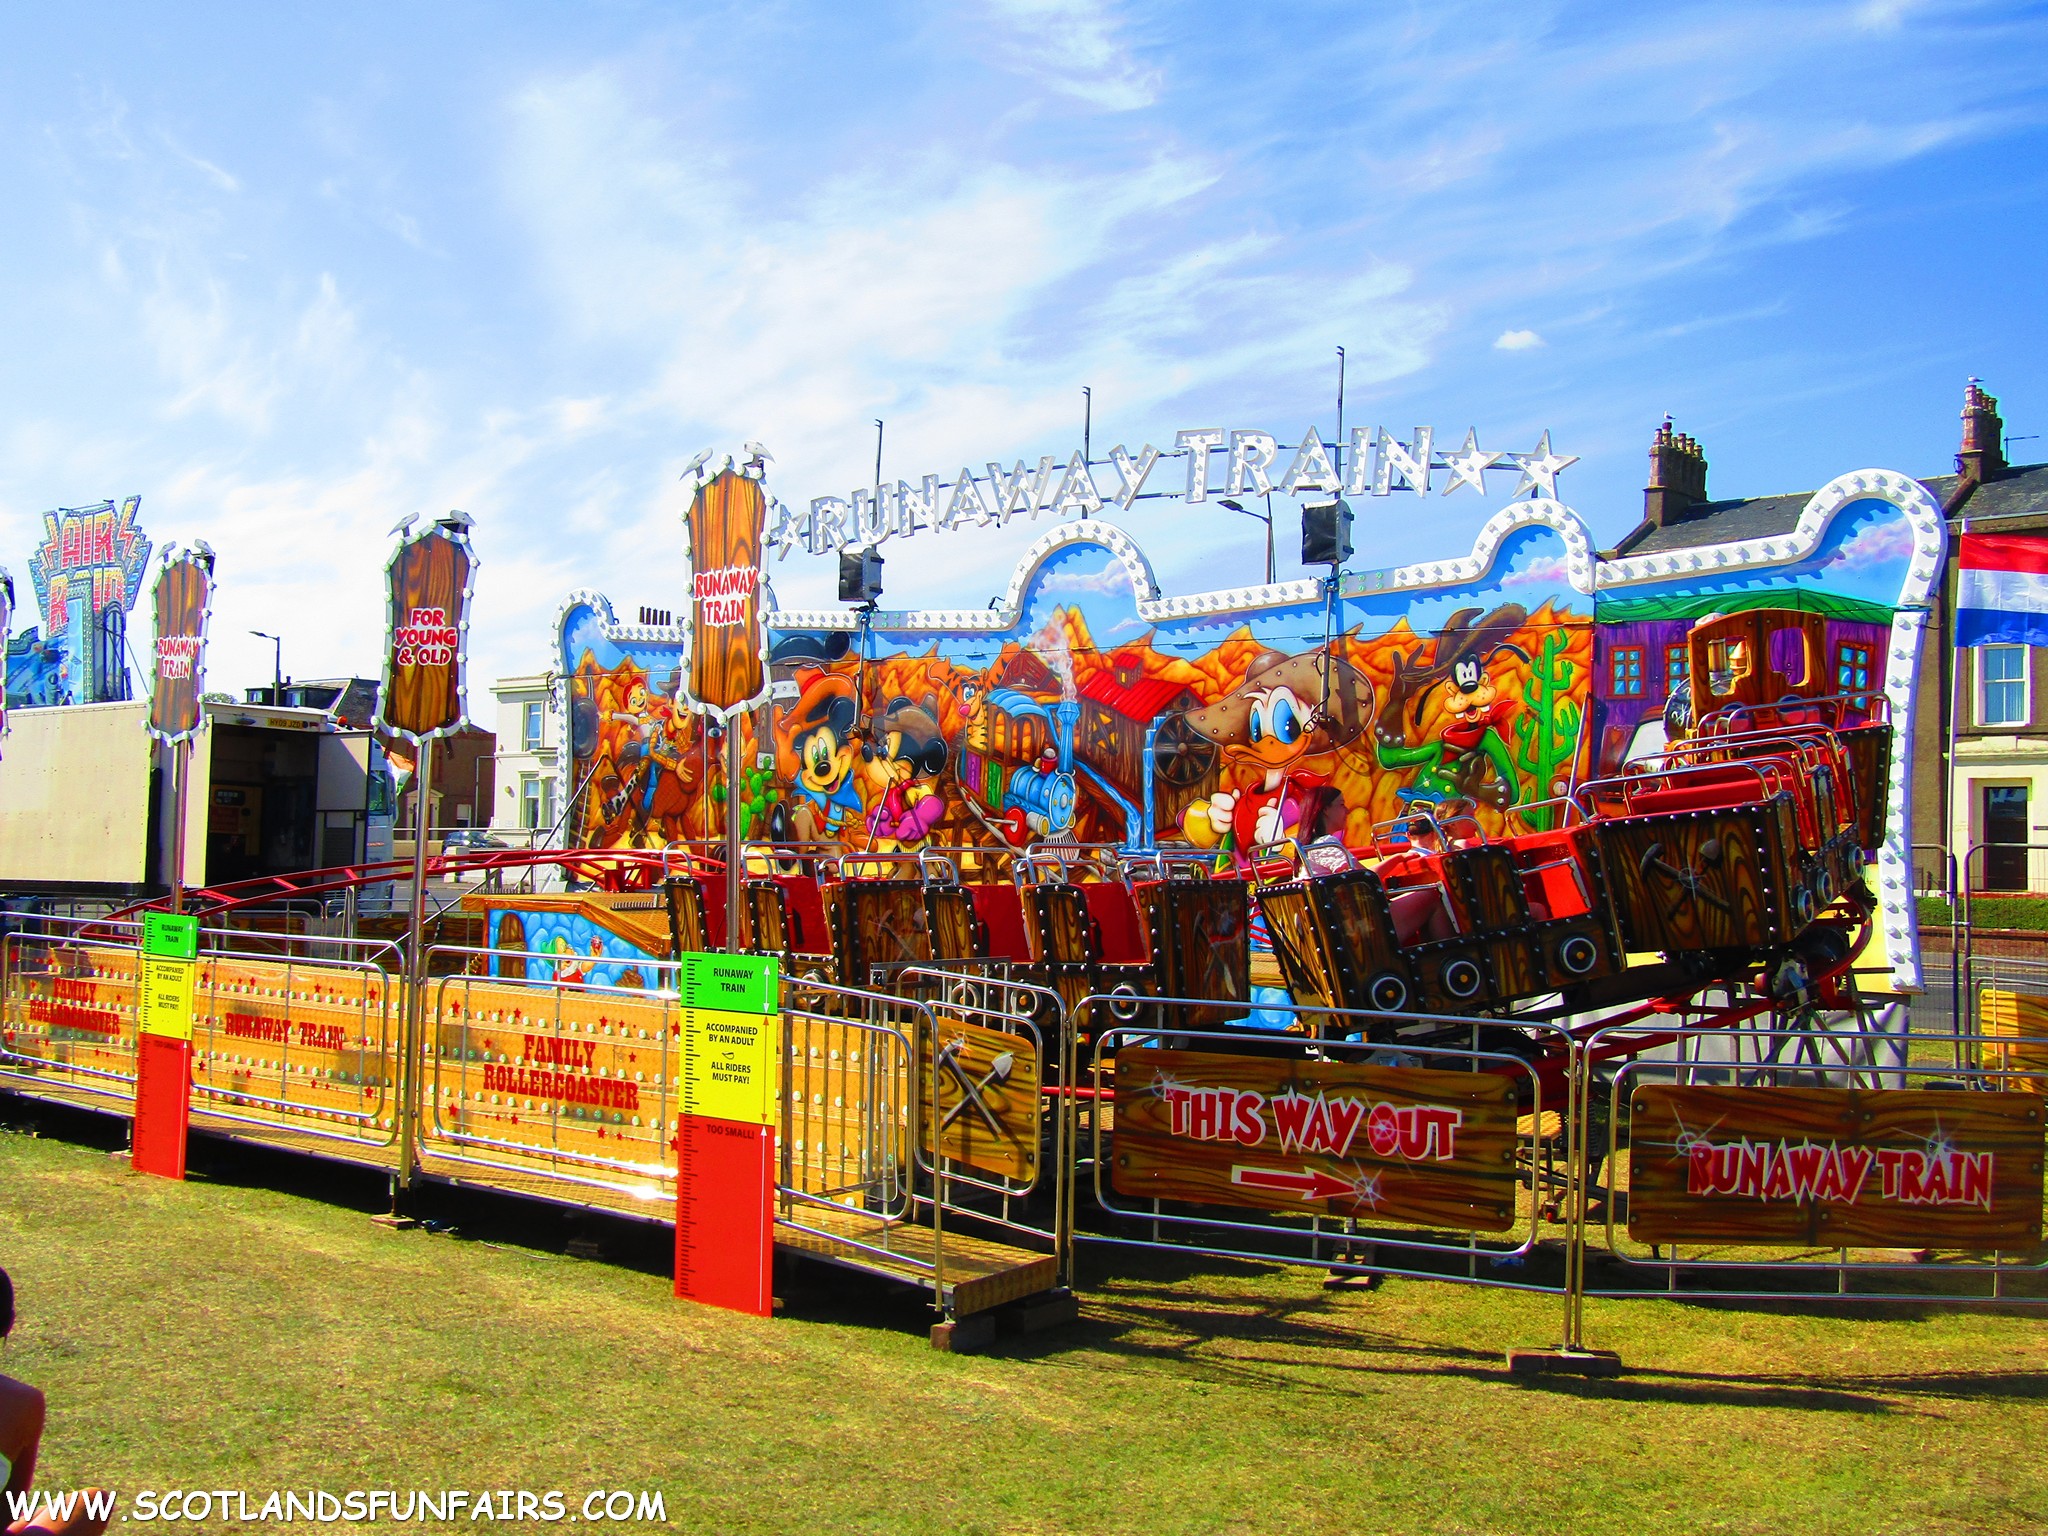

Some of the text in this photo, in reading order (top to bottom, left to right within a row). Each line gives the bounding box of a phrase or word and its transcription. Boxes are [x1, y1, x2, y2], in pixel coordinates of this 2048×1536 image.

[810, 425, 1435, 555] RUNAWAY TRAIN
[60, 509, 116, 570] AIR
[693, 564, 758, 601] RUNAWAY
[48, 566, 125, 634] RID
[411, 608, 446, 627] FOR
[703, 599, 746, 627] TRAIN
[157, 634, 199, 659] RUNAWAY
[393, 626, 458, 648] YOUNG
[397, 647, 452, 666] & OLD
[163, 659, 191, 680] TRAIN
[161, 924, 184, 932] RUNAWAY
[165, 934, 179, 943] TRAIN
[713, 967, 754, 980] RUNAWAY
[53, 977, 97, 1004] FAMILY
[720, 982, 746, 993] TRAIN
[29, 999, 121, 1036] ROLLERCOASTER
[705, 1022, 758, 1036] ACCOMPANIED
[225, 1012, 345, 1051] RUNAWAY TRAIN
[708, 1033, 755, 1047] BY AN ADULT
[523, 1034, 596, 1069] FAMILY
[710, 1061, 752, 1074] ALL RIDERS
[712, 1072, 751, 1085] MUST PAY!
[483, 1063, 640, 1111] ROLLERCOASTER
[706, 1123, 755, 1141] TOO SMALL!
[1163, 1084, 1462, 1162] THIS WAY OUT
[1687, 1135, 1994, 1213] RUNAWAY TRAIN
